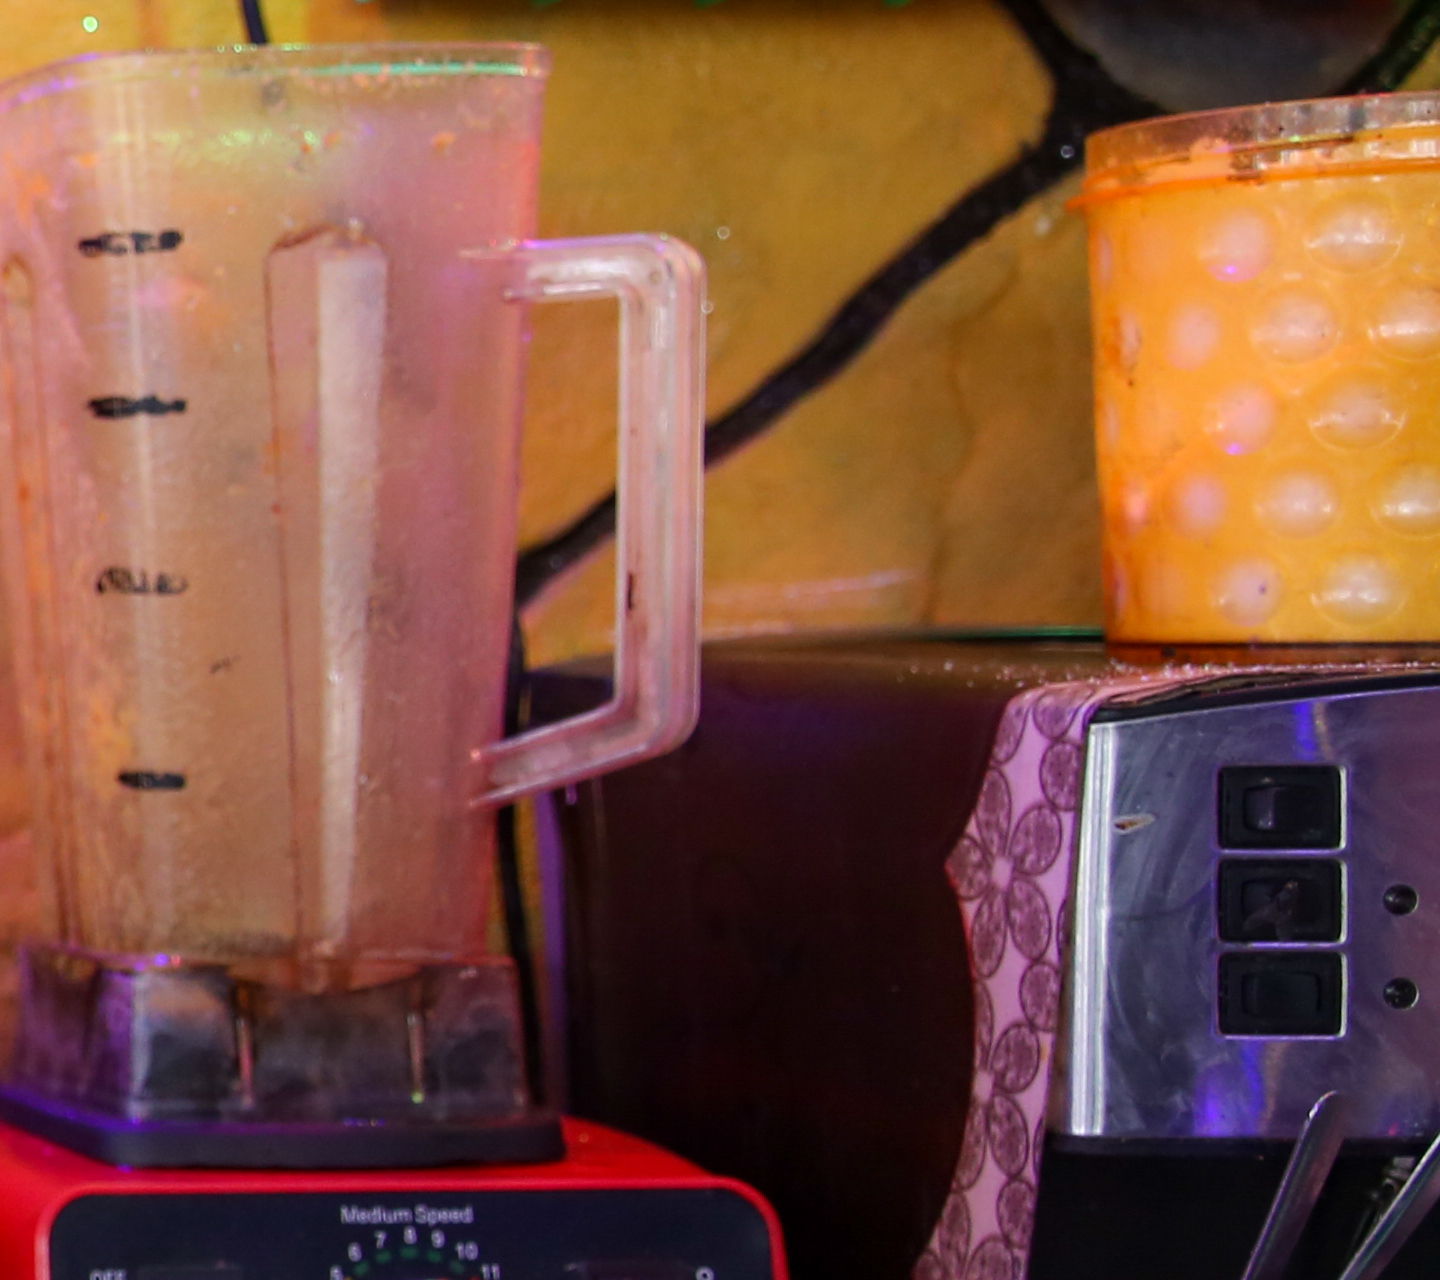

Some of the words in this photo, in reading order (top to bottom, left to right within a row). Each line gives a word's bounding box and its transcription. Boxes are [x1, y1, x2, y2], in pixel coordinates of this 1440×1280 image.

[340, 1204, 413, 1224] Medium
[415, 1204, 474, 1226] Speed
[347, 1242, 362, 1262] 6
[374, 1229, 387, 1249] 7
[403, 1225, 417, 1245] 8
[431, 1228, 445, 1248] 9
[455, 1240, 479, 1261] 10
